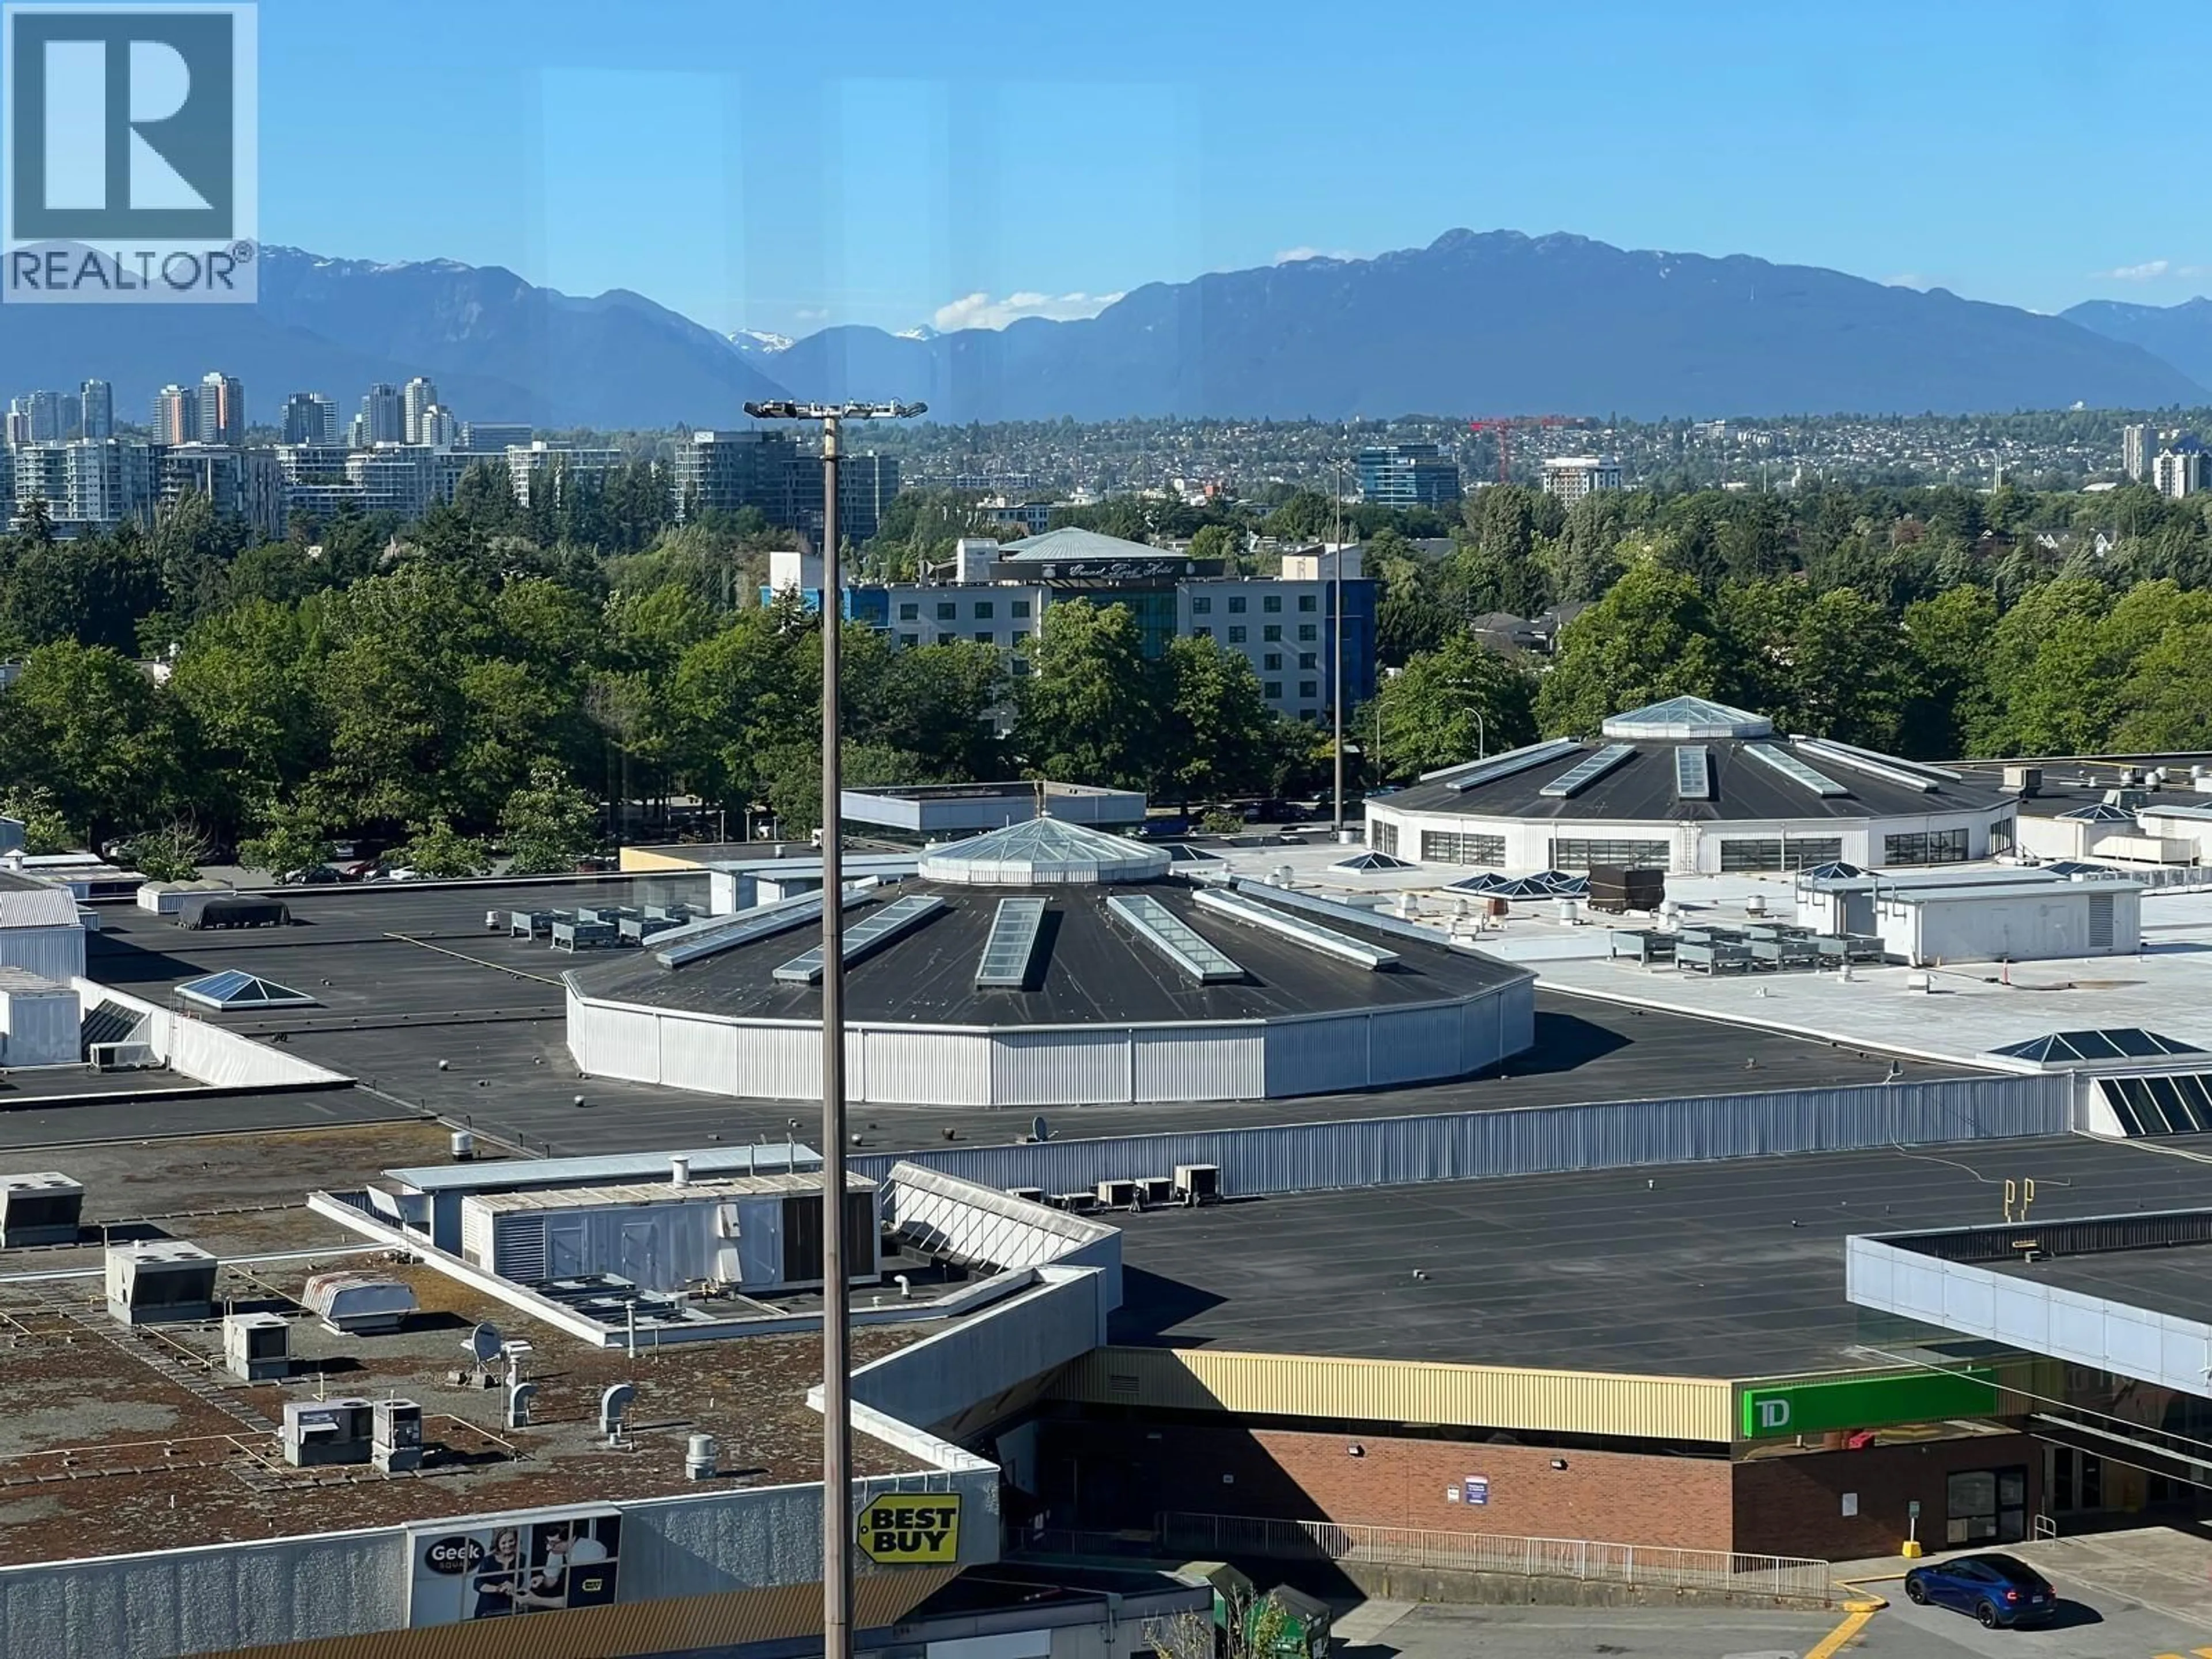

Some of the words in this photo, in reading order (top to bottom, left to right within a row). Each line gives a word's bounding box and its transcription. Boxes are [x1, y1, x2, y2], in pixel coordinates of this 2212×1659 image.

[1755, 1399, 1790, 1427] TD
[871, 1508, 956, 1529] BEST
[873, 1530, 949, 1552] BUY
[431, 1544, 480, 1560] Geek
